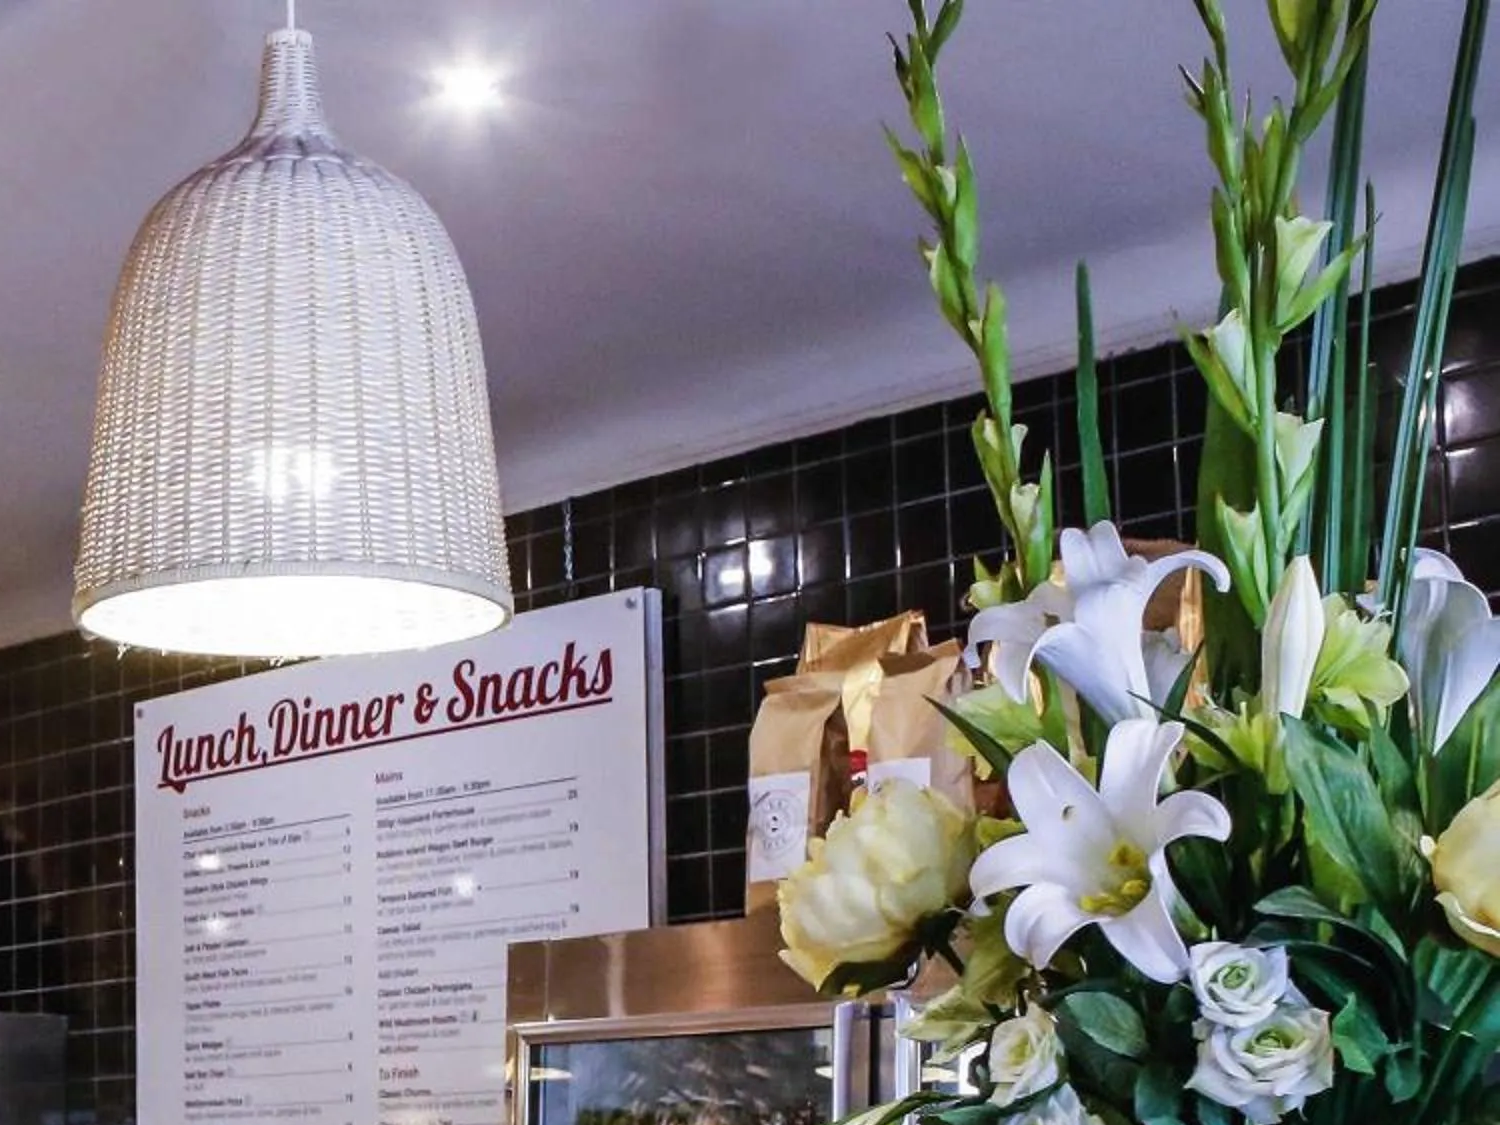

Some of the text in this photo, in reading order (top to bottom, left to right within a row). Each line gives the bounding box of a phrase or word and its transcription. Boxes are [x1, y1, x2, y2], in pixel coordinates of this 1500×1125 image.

[268, 692, 404, 757] Dinner
[414, 682, 440, 725] &
[447, 641, 612, 723] Snacks
[375, 771, 404, 784] Mains
